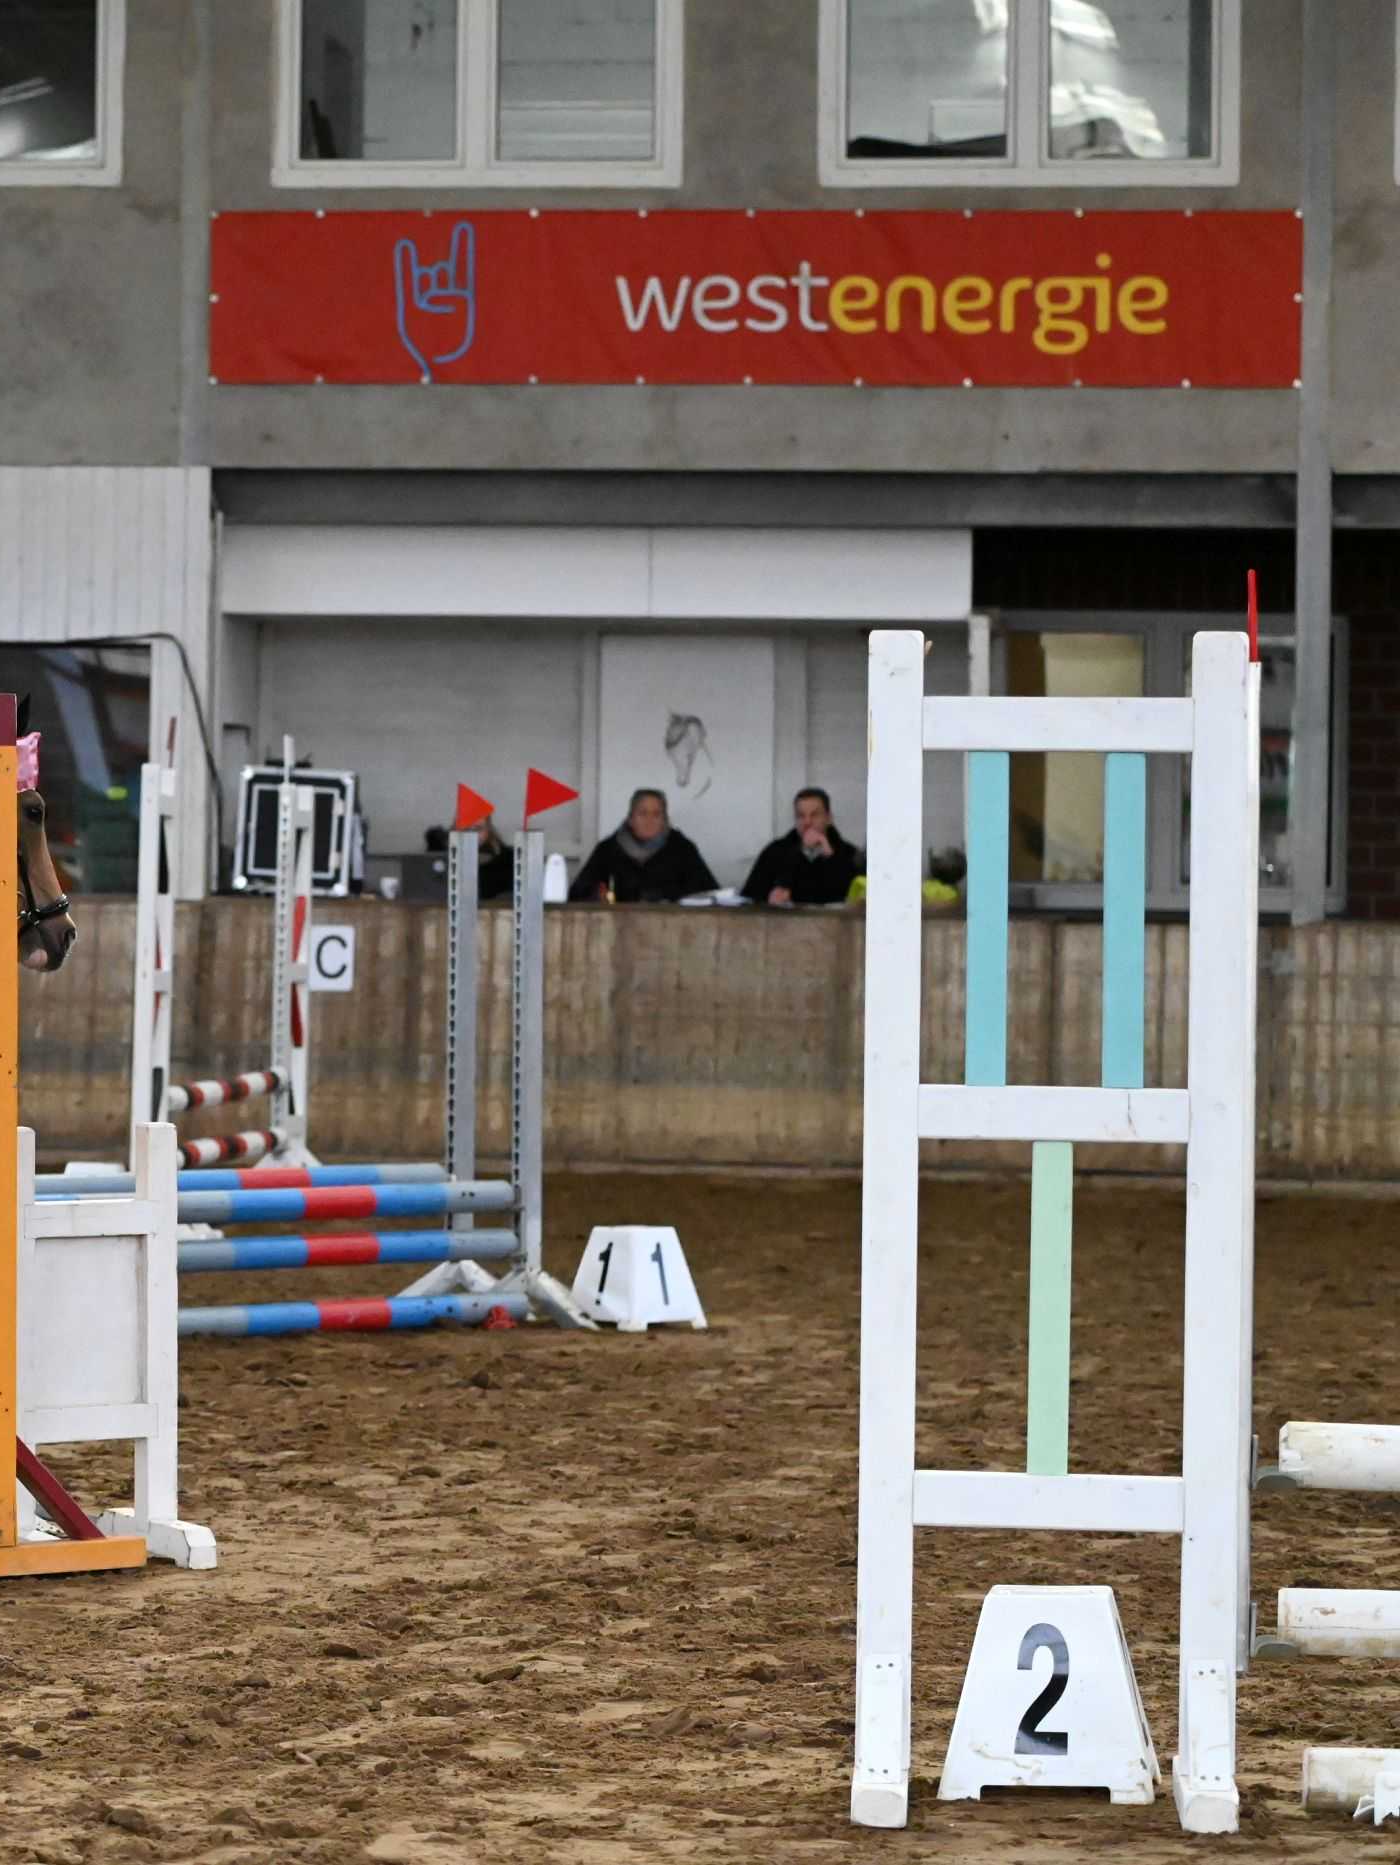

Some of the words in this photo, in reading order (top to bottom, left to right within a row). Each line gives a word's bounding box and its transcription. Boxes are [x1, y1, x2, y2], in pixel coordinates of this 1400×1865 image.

[615, 252, 1170, 356] westenergie
[315, 934, 348, 979] C
[596, 1241, 613, 1304] 1
[650, 1241, 669, 1306] 1
[1014, 1622, 1070, 1755] 2
